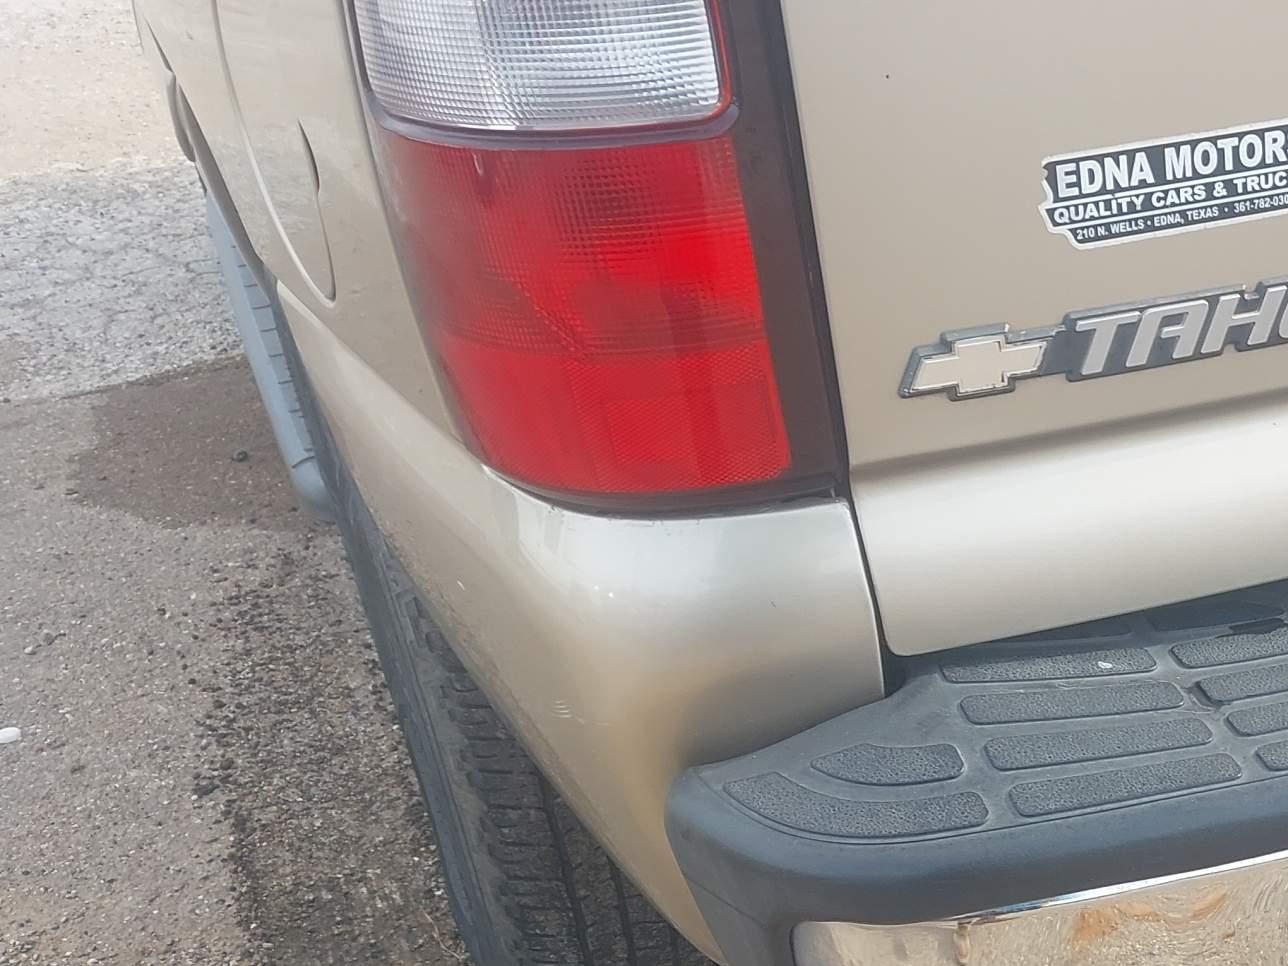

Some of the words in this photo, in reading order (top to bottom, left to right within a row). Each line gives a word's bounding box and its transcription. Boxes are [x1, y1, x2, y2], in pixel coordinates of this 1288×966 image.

[1055, 151, 1155, 198] EDNA
[1053, 194, 1146, 224] QUALITY
[1152, 184, 1206, 208] CARS
[1212, 181, 1228, 197] &
[1075, 227, 1096, 241] 210
[1097, 225, 1109, 237] N.
[1109, 219, 1145, 235] WELLS
[1154, 213, 1184, 227] EDNA,
[1186, 207, 1219, 222] TEXAS
